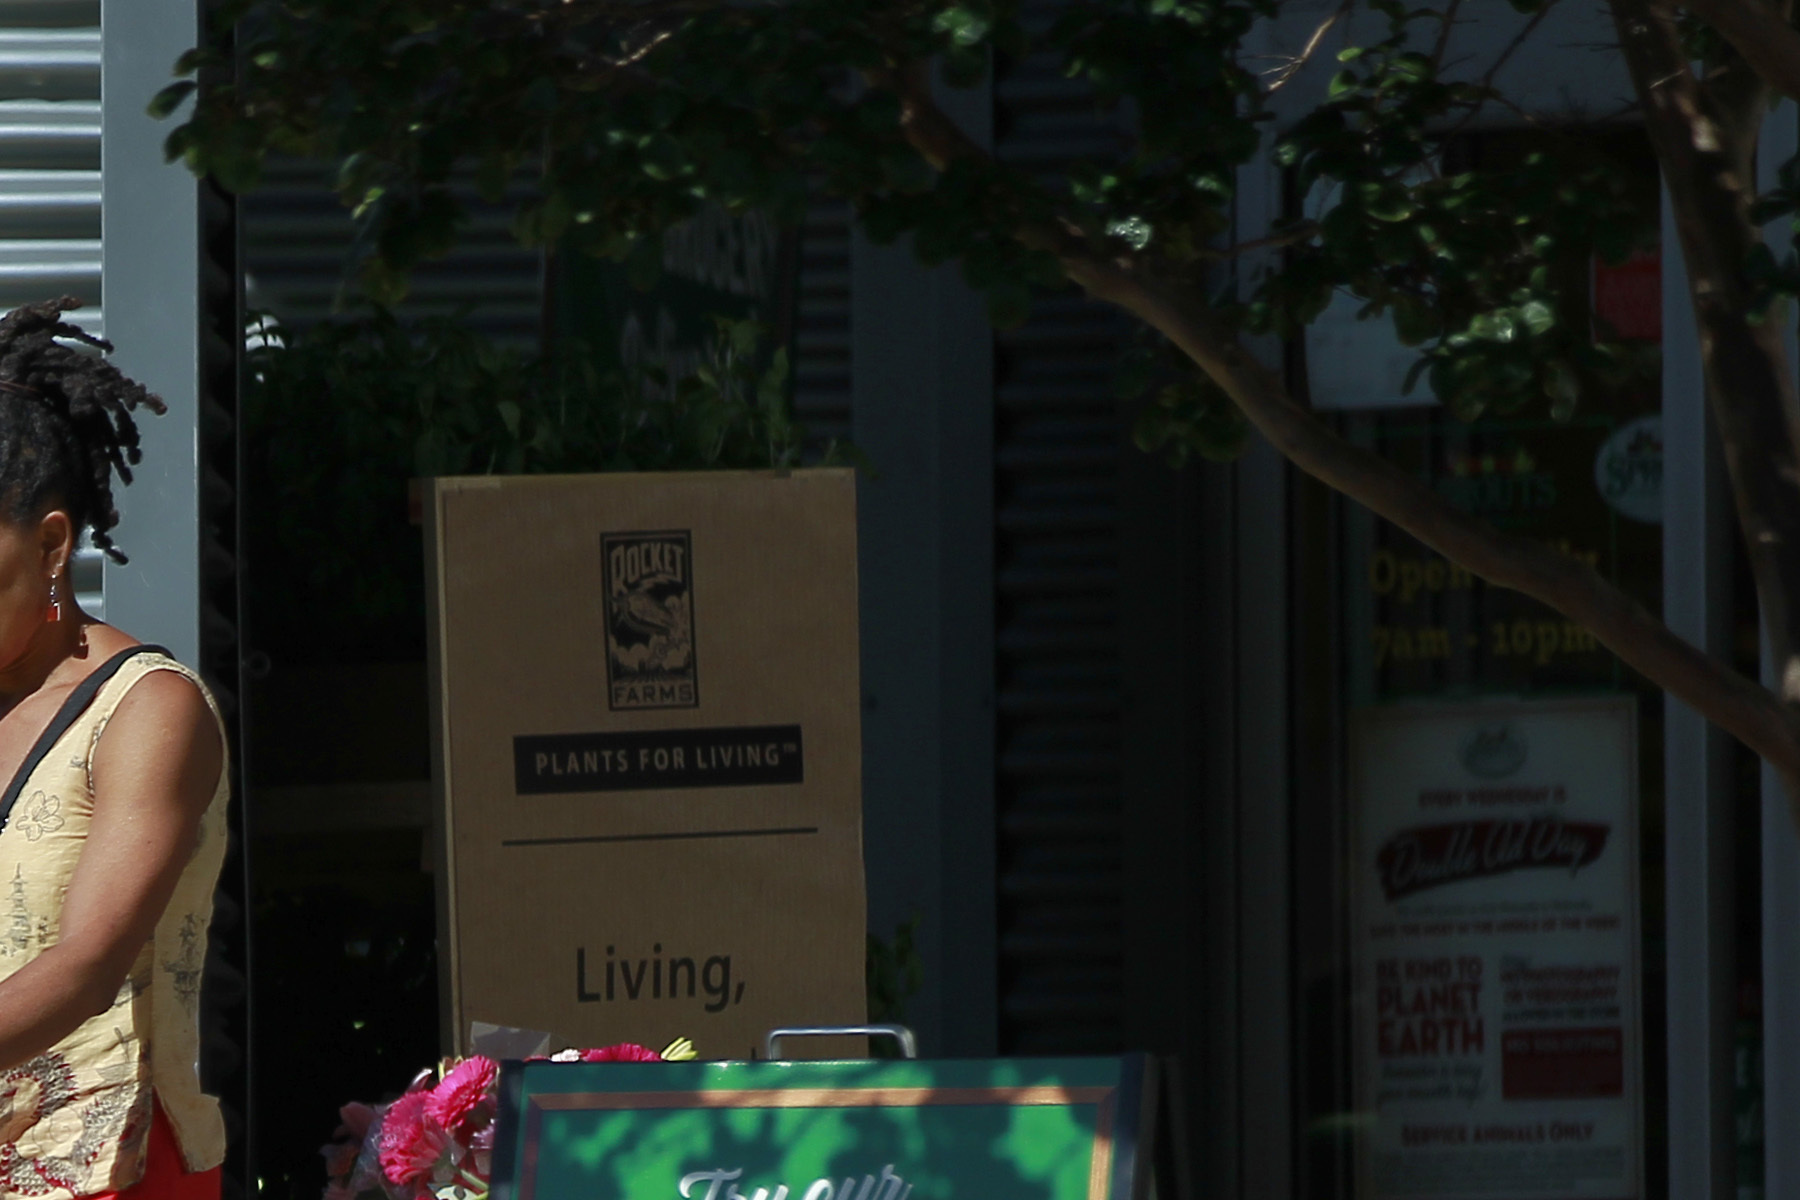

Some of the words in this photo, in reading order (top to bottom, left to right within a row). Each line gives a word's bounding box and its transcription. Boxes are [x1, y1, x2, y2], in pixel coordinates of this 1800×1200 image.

[611, 543, 685, 597] ROCKET
[613, 684, 695, 705] FARMS
[536, 749, 629, 776] PLANTS
[639, 746, 685, 772] FOR
[574, 943, 746, 1013] Living,
[1376, 983, 1482, 1015] PLANET
[1377, 1018, 1485, 1057] EARTH
